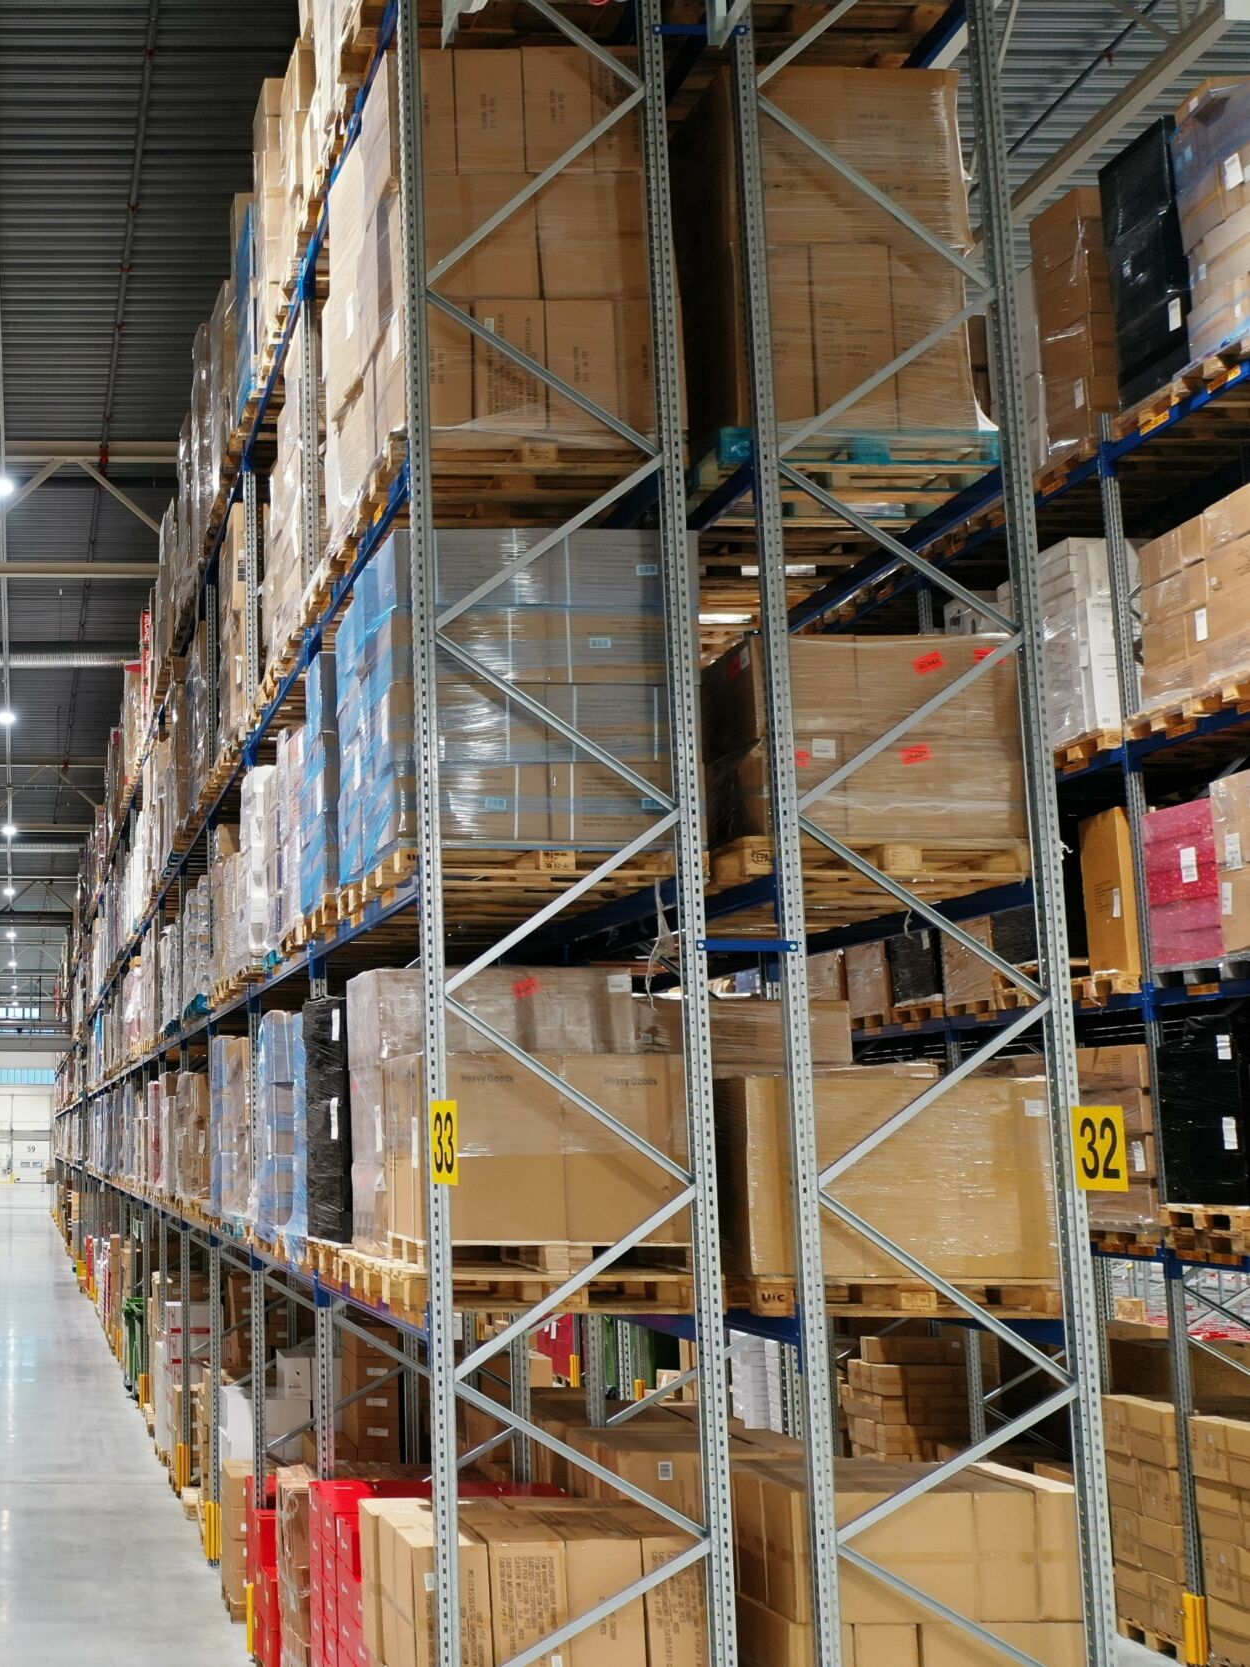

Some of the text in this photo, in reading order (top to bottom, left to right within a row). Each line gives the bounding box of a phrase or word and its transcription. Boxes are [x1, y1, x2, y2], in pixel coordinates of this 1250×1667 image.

[26, 1145, 36, 1153] 59
[433, 1111, 454, 1174] 33
[1079, 1117, 1120, 1179] 32
